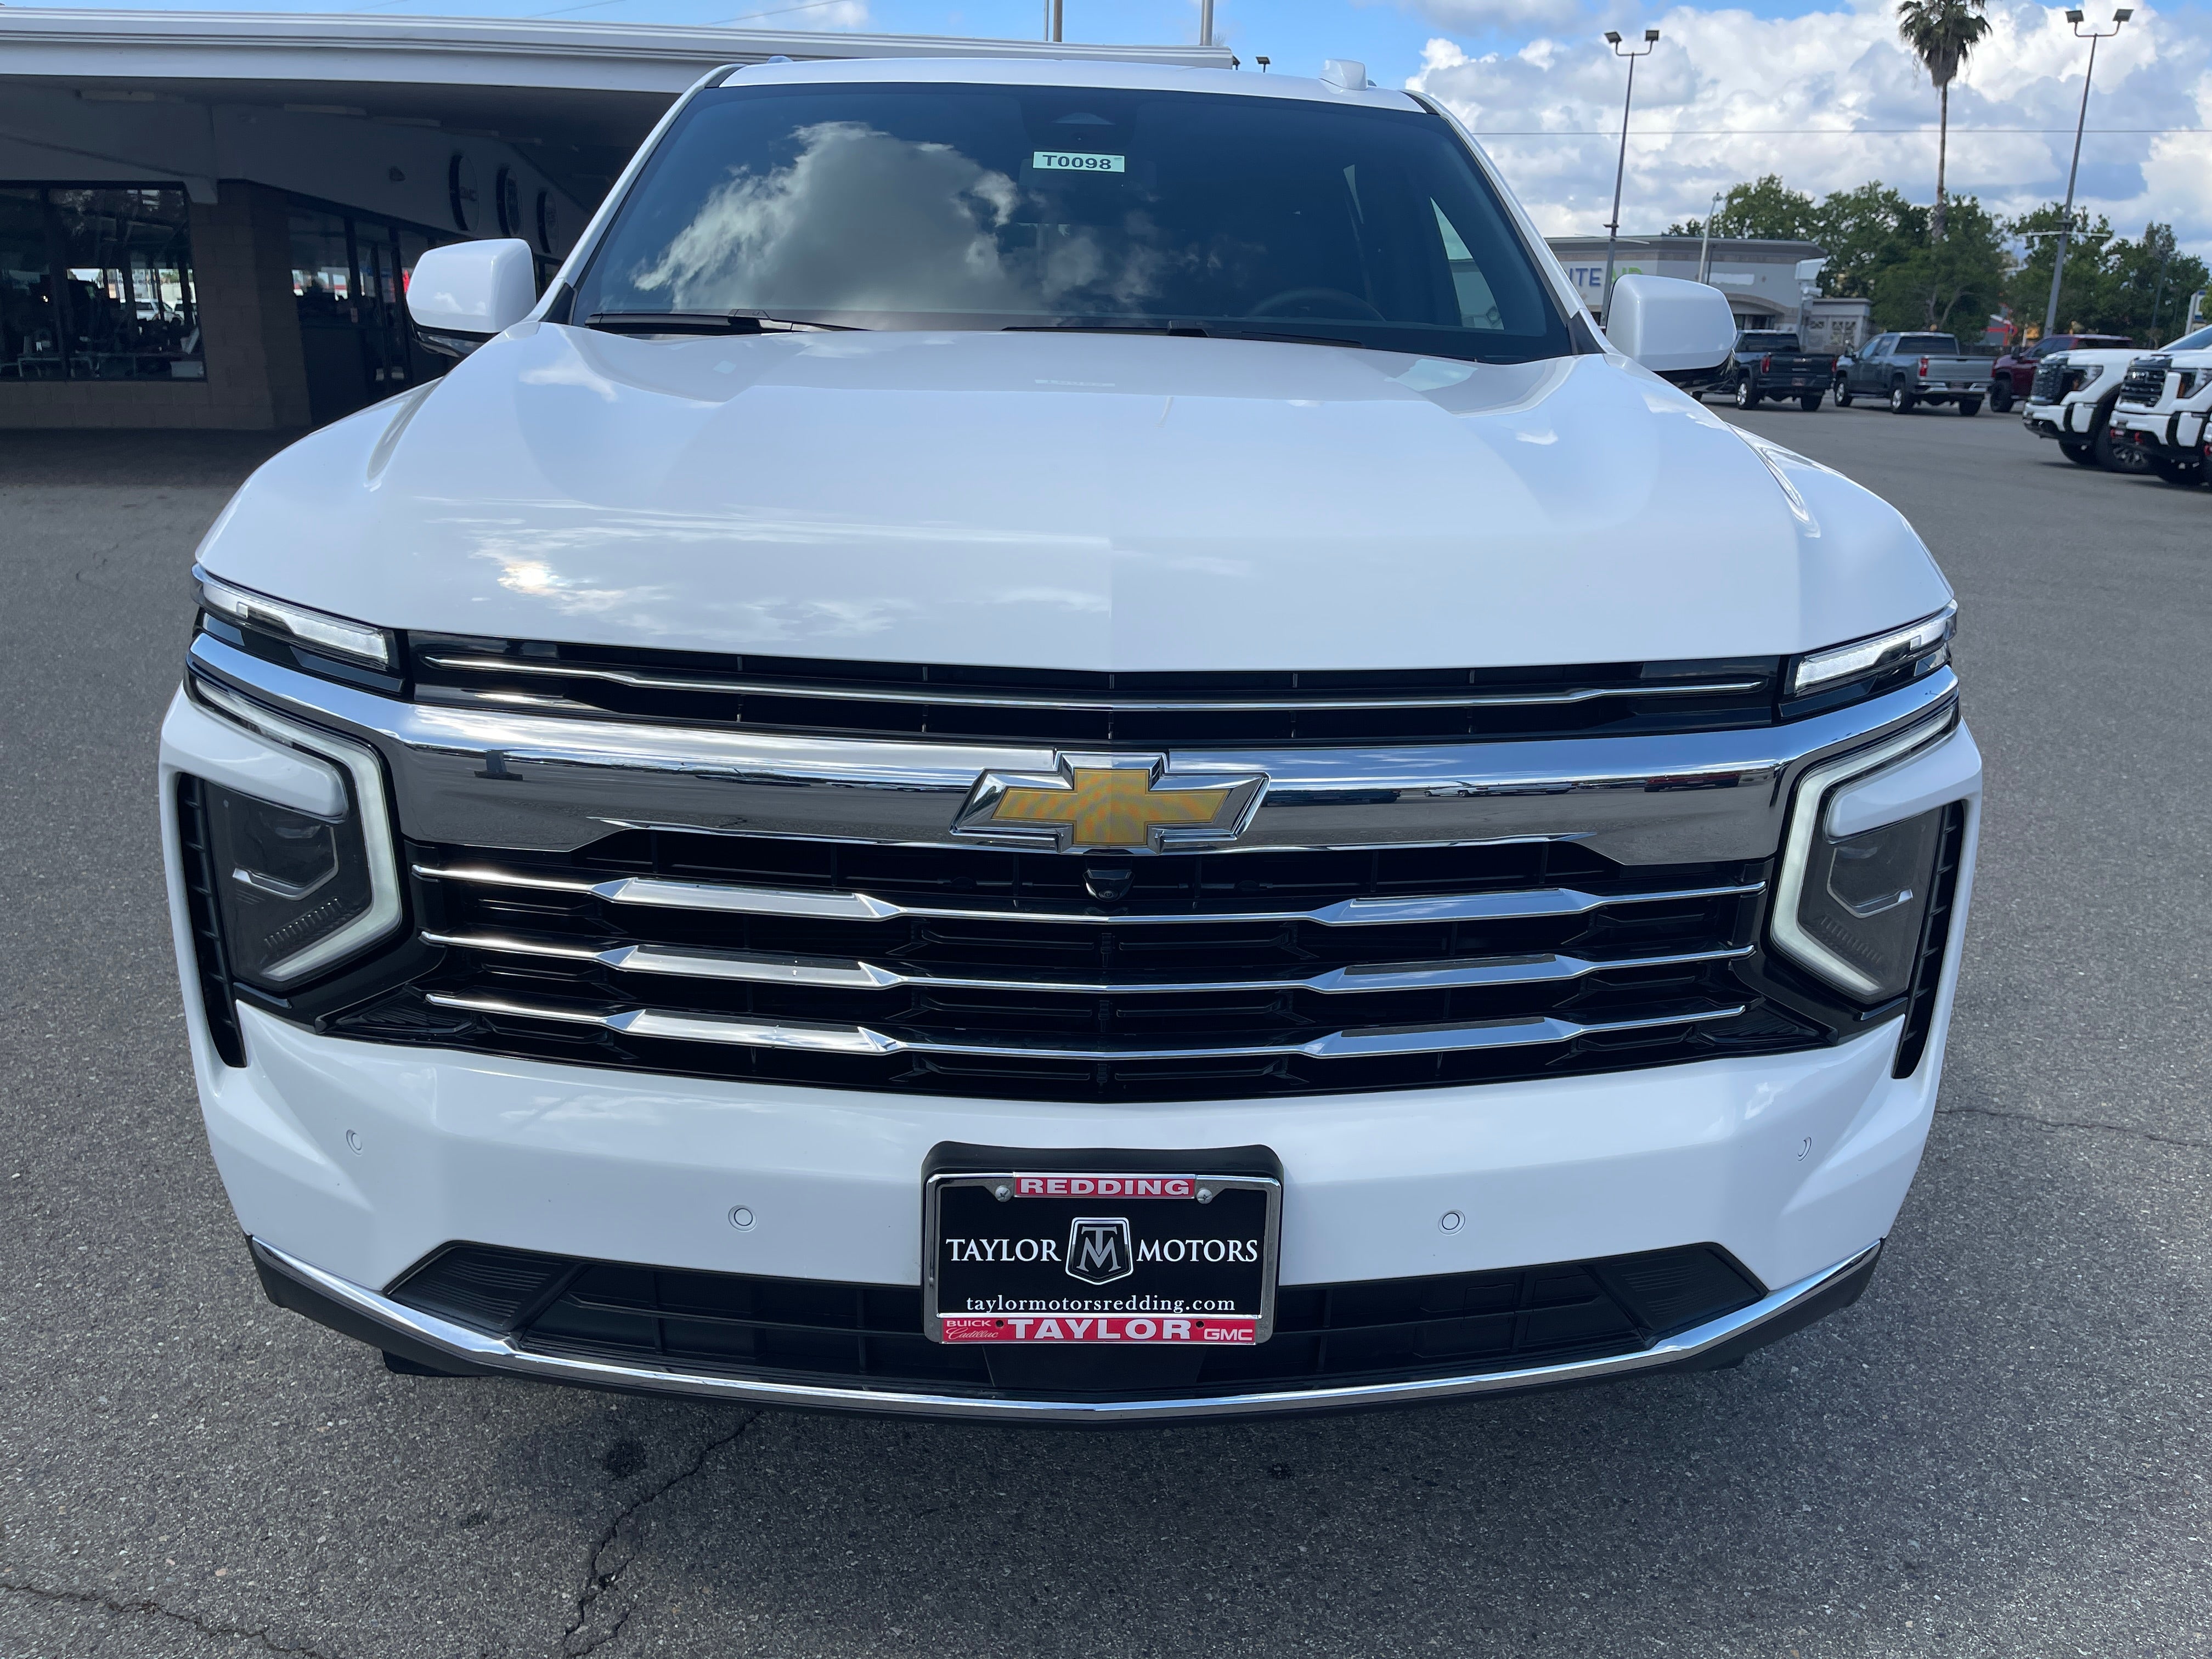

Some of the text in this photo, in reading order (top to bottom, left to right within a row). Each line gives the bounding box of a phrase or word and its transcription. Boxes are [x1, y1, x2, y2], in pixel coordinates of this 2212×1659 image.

[1042, 154, 1111, 170] T0098
[1568, 267, 1602, 287] ITE
[1020, 1178, 1189, 1195] REDDING
[946, 1238, 1062, 1261] TAYLOR
[1136, 1239, 1258, 1262] MOTORS
[966, 1295, 1235, 1313] taylormotorsredding.com
[945, 1327, 999, 1340] Cadillac
[1007, 1318, 1192, 1340] TAYLOR
[1203, 1328, 1254, 1341] GMC
